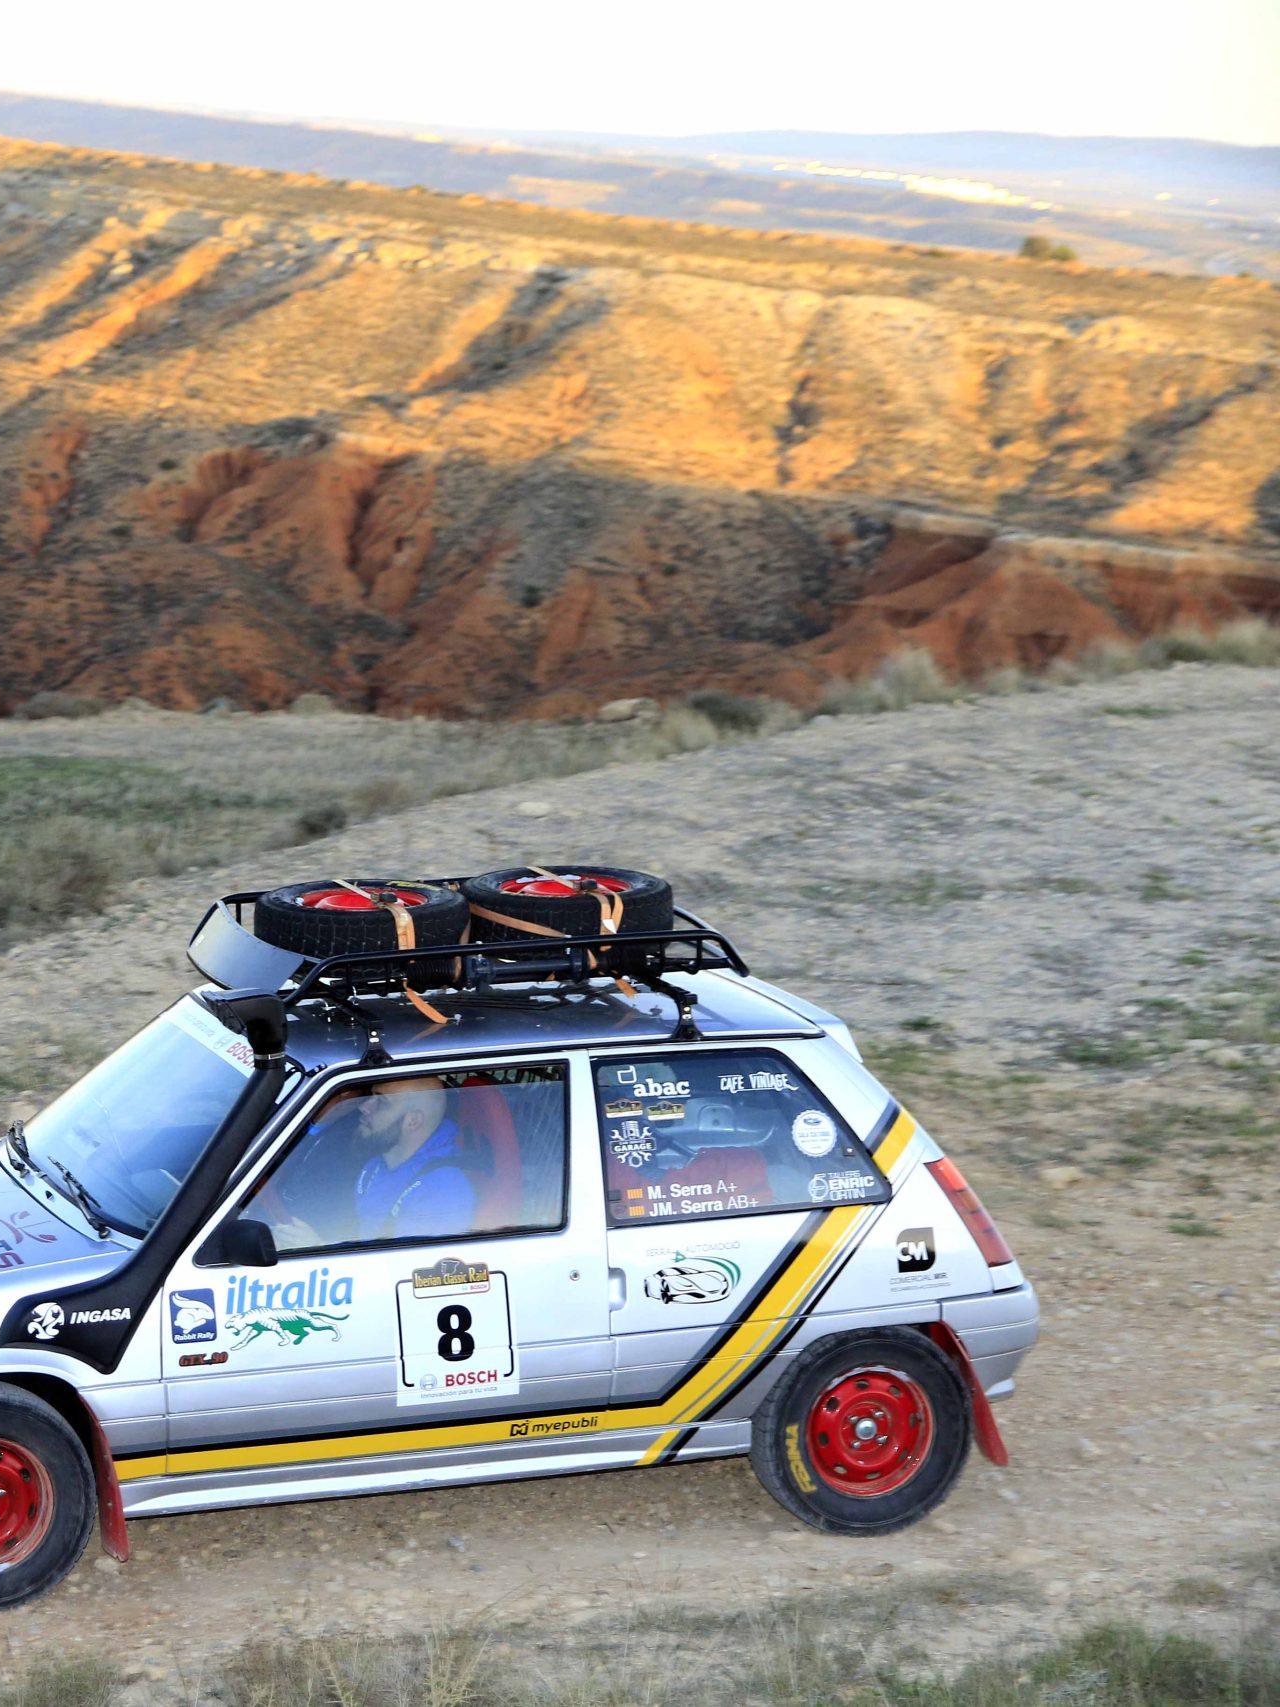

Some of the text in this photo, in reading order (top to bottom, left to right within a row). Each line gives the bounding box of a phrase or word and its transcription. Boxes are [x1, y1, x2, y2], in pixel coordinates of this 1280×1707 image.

[633, 1078, 690, 1098] abac
[614, 1142, 653, 1152] GARAGE
[647, 1179, 738, 1200] M. Serra A+
[828, 1176, 875, 1190] ENRIC
[649, 1194, 760, 1217] JM. Serra AB+
[443, 1272, 467, 1285] Classic
[468, 1267, 488, 1283] Raid
[225, 1267, 354, 1314] iltralia
[69, 1308, 132, 1325] INGASA
[173, 1331, 216, 1341] Rabbit Rally
[437, 1304, 475, 1362] 8
[444, 1369, 498, 1388] BOSCH
[531, 1416, 599, 1434] myepubli
